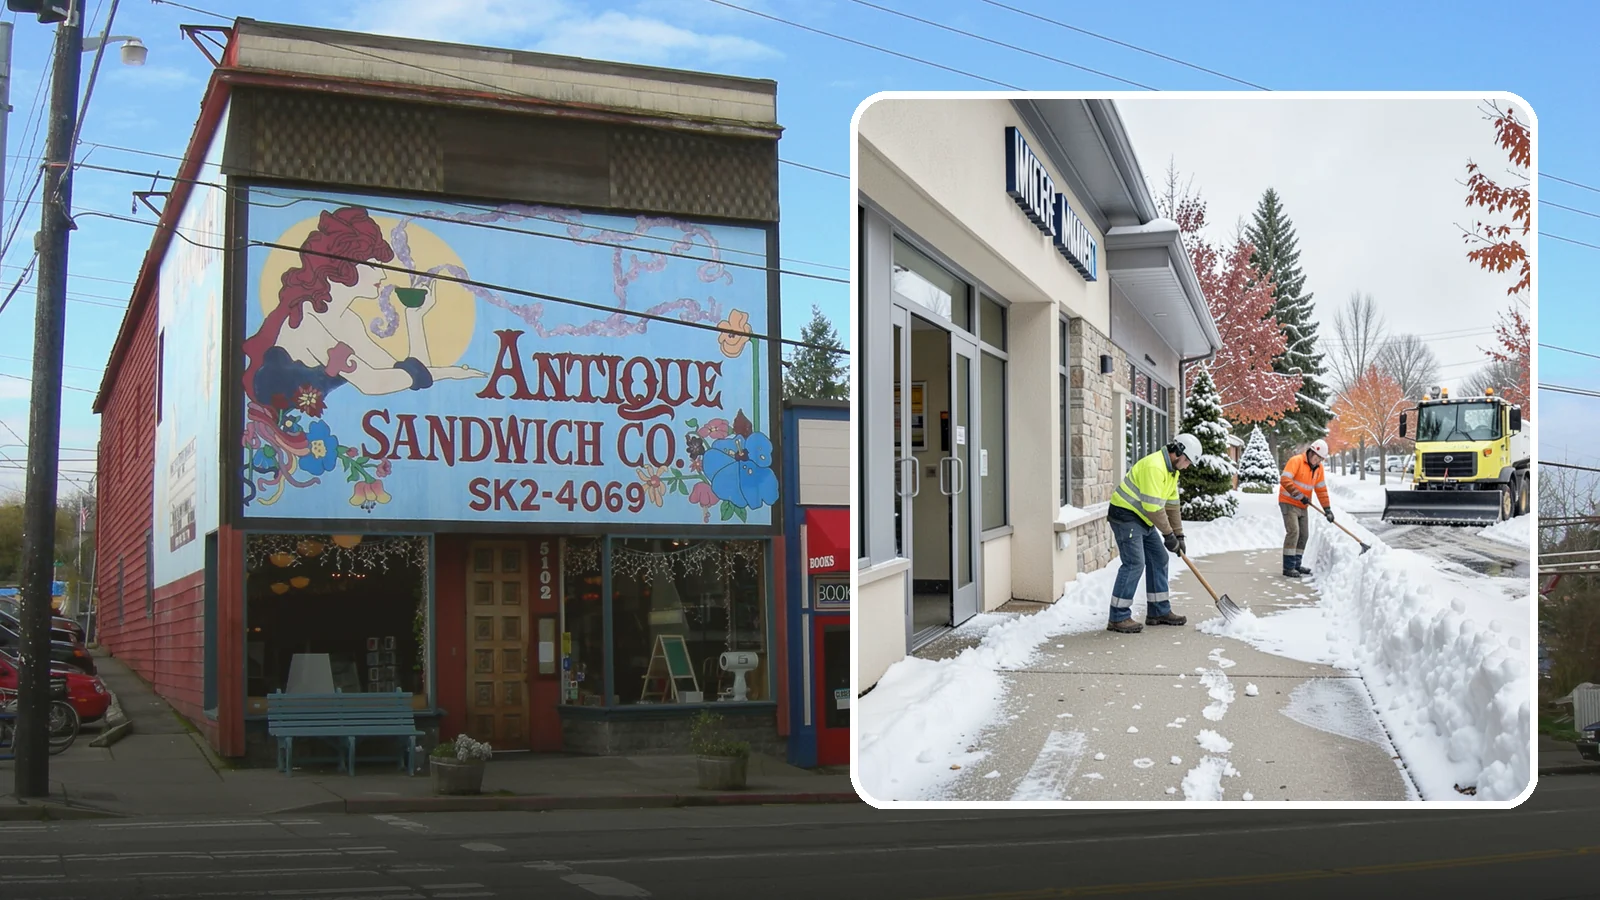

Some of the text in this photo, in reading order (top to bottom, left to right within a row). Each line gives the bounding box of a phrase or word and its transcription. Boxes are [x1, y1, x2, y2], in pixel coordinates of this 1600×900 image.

[475, 329, 723, 421] ANTIQUE
[361, 408, 685, 468] SANDWICH CO.
[468, 476, 645, 513] SK2-4069
[540, 542, 551, 599] 5102
[810, 555, 834, 568] BOOKS
